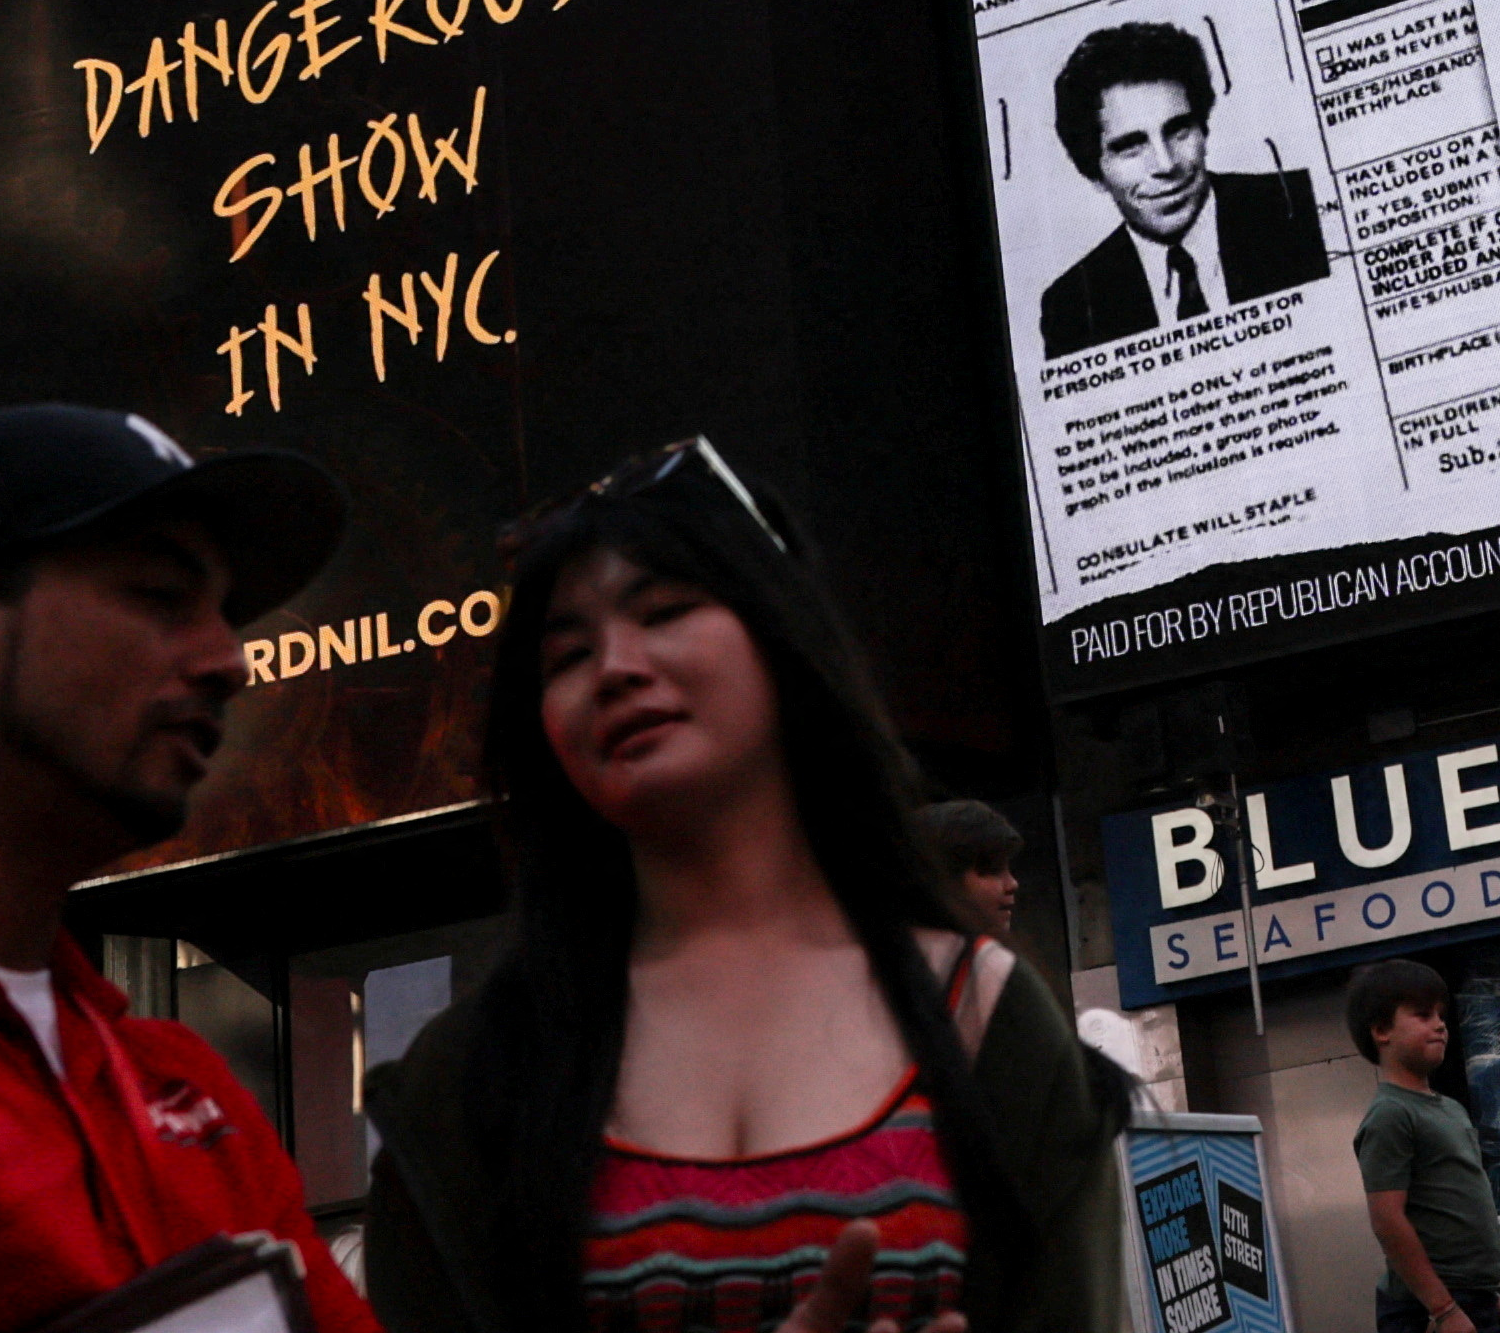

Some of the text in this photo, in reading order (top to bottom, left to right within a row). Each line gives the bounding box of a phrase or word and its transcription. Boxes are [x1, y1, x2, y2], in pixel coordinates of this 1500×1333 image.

[212, 85, 488, 266] SHOW
[215, 302, 320, 419] IN
[1071, 619, 1131, 664] PAID
[1134, 608, 1185, 652] FOR
[1188, 597, 1228, 640] BY
[1228, 562, 1391, 632] REPUBLICAN
[1139, 1169, 1201, 1225] EXPLORE
[1223, 1204, 1249, 1239] 47TH
[1148, 1215, 1191, 1264] MORE
[1224, 1234, 1262, 1273] STREET
[1156, 1245, 1216, 1303] IN TIMES
[1165, 1283, 1223, 1333] SQUARE
